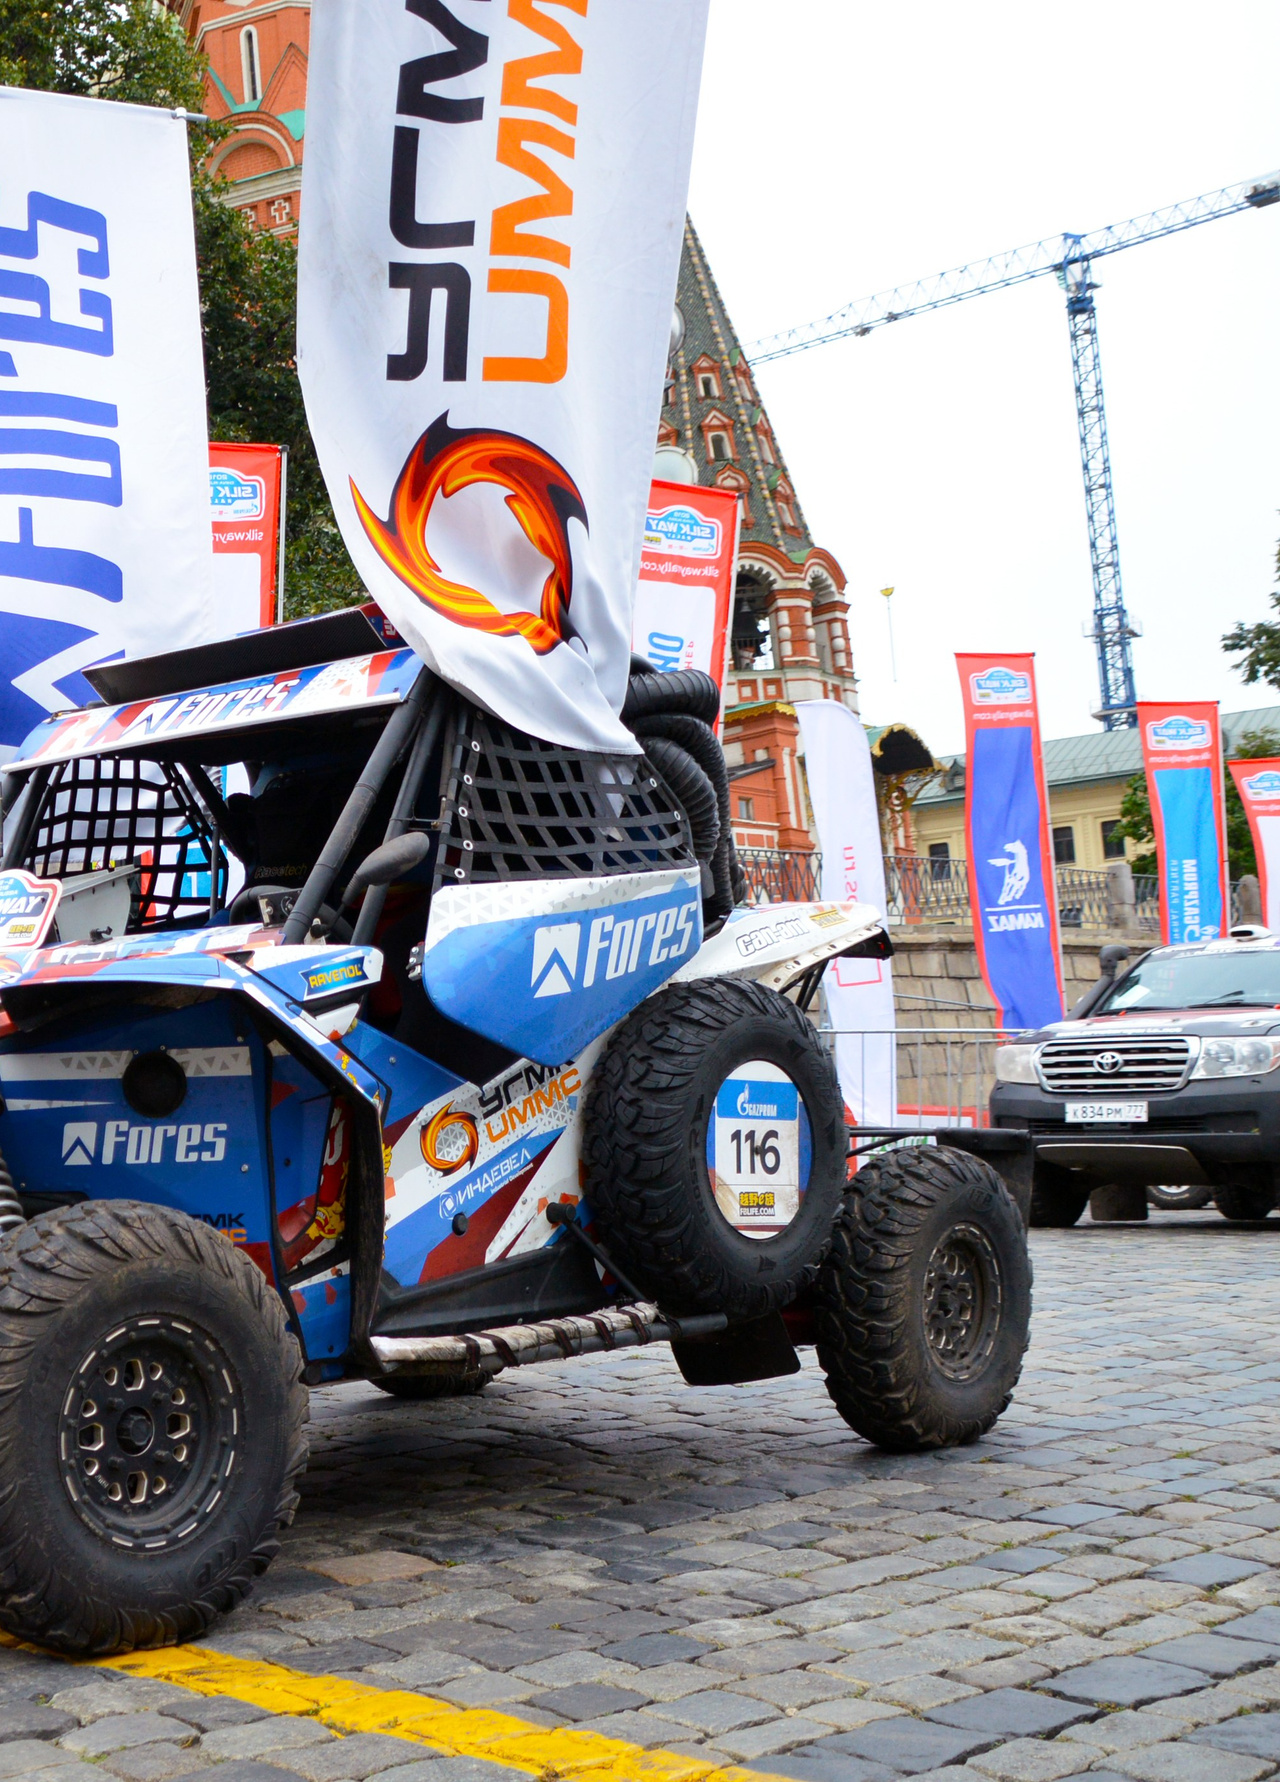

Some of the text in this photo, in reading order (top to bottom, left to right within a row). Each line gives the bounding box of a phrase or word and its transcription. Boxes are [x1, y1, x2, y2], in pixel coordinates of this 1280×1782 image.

[309, 964, 363, 988] RAVENOL
[485, 1068, 582, 1143] UMMC
[748, 1104, 777, 1117] GAZPROM
[731, 1129, 781, 1175] 116
